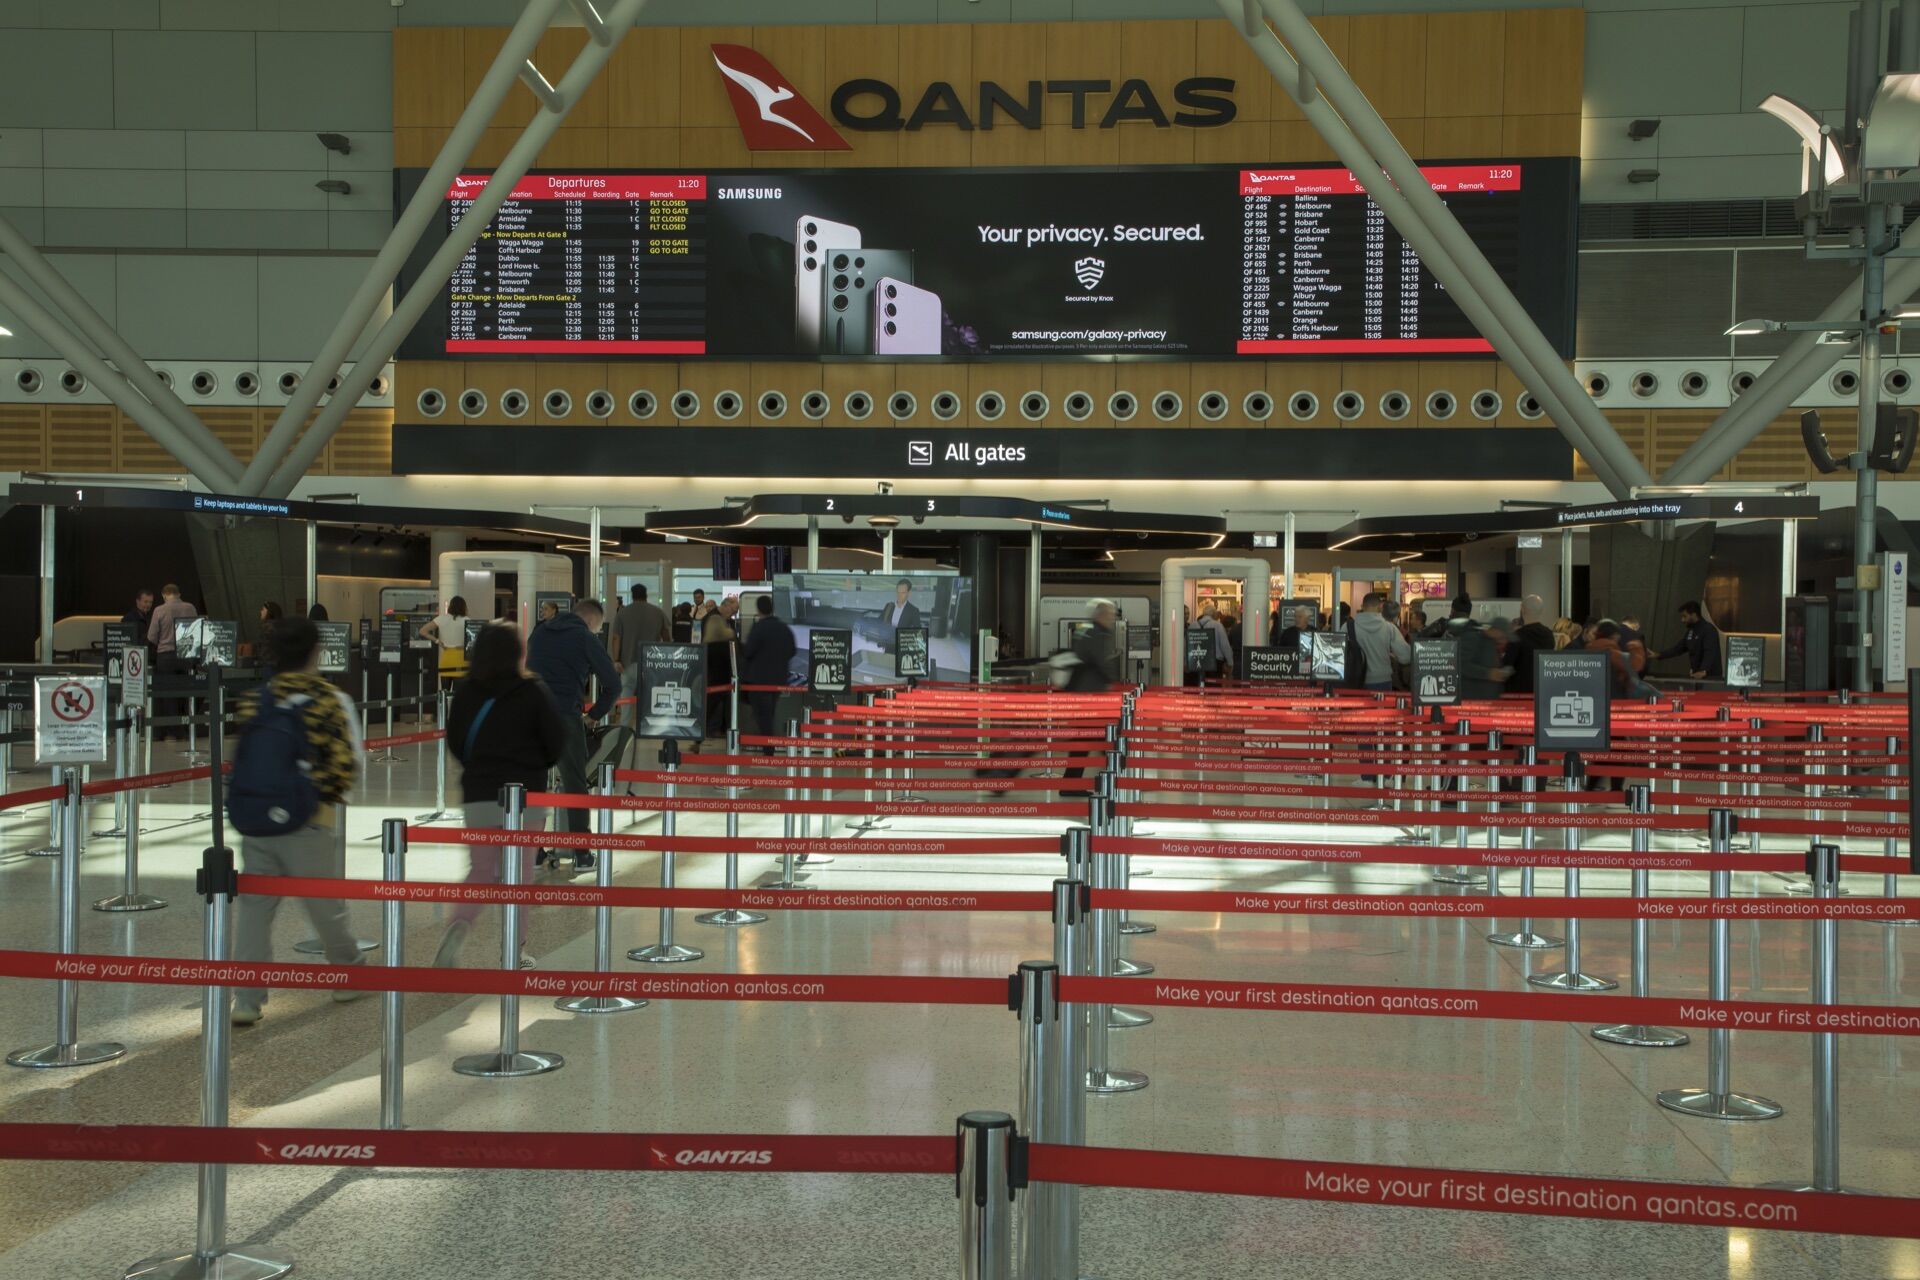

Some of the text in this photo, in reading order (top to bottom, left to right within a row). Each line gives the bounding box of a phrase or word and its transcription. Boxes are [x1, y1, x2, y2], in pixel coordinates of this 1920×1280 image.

[830, 78, 1237, 131] QANTAS
[1490, 170, 1512, 179] 11:20
[549, 177, 699, 190] Departures 11:20
[451, 191, 468, 199] Flight
[593, 191, 620, 199] Boarding
[718, 188, 782, 199] SAMSUNG
[1245, 187, 1263, 195] Flight
[512, 231, 536, 239] Departs
[978, 224, 1204, 248] Your privacy. Secured.
[498, 240, 520, 248] Wagga
[522, 240, 544, 248] Wagga
[1012, 329, 1167, 342] samsung.com/galaxy-privacy
[945, 443, 1026, 466] All gates
[77, 490, 82, 501] 1
[204, 499, 216, 508] Keep
[217, 500, 236, 509] laptops
[246, 503, 262, 511] tablets
[279, 505, 288, 514] bag
[827, 499, 834, 510] 2
[928, 500, 935, 511] 3
[1735, 502, 1743, 513] 4
[1574, 512, 1587, 521] jackets,
[1587, 511, 1595, 519] hats,
[1622, 507, 1638, 515] clothing
[1652, 505, 1664, 513] the
[1665, 505, 1681, 513] tray
[1251, 651, 1290, 662] Prepare
[1251, 662, 1292, 673] Security
[1544, 659, 1566, 670] Keep
[1567, 660, 1577, 668] all
[1544, 668, 1591, 678] in your bag.
[621, 799, 643, 807] Make
[666, 800, 681, 808] first
[683, 801, 730, 809] destination
[733, 802, 780, 811] qantas.com
[461, 832, 645, 847] Make your first destination qantas.com
[1482, 853, 1691, 867] Make your first destination qantas.com
[742, 894, 977, 908] Make your first destination qantas.com
[1236, 897, 1484, 913] Make your first destination qantas.com
[56, 960, 348, 984] Make your first destination qantas.com
[525, 976, 824, 997] Make your first destination qantas.com
[1157, 985, 1478, 1011] Make your first destination qantas.com
[1680, 1006, 1920, 1028] Make your first destination
[280, 1144, 772, 1165] QANTAS QANTAS
[1306, 1171, 1797, 1221] Make your first destination qantas.com
